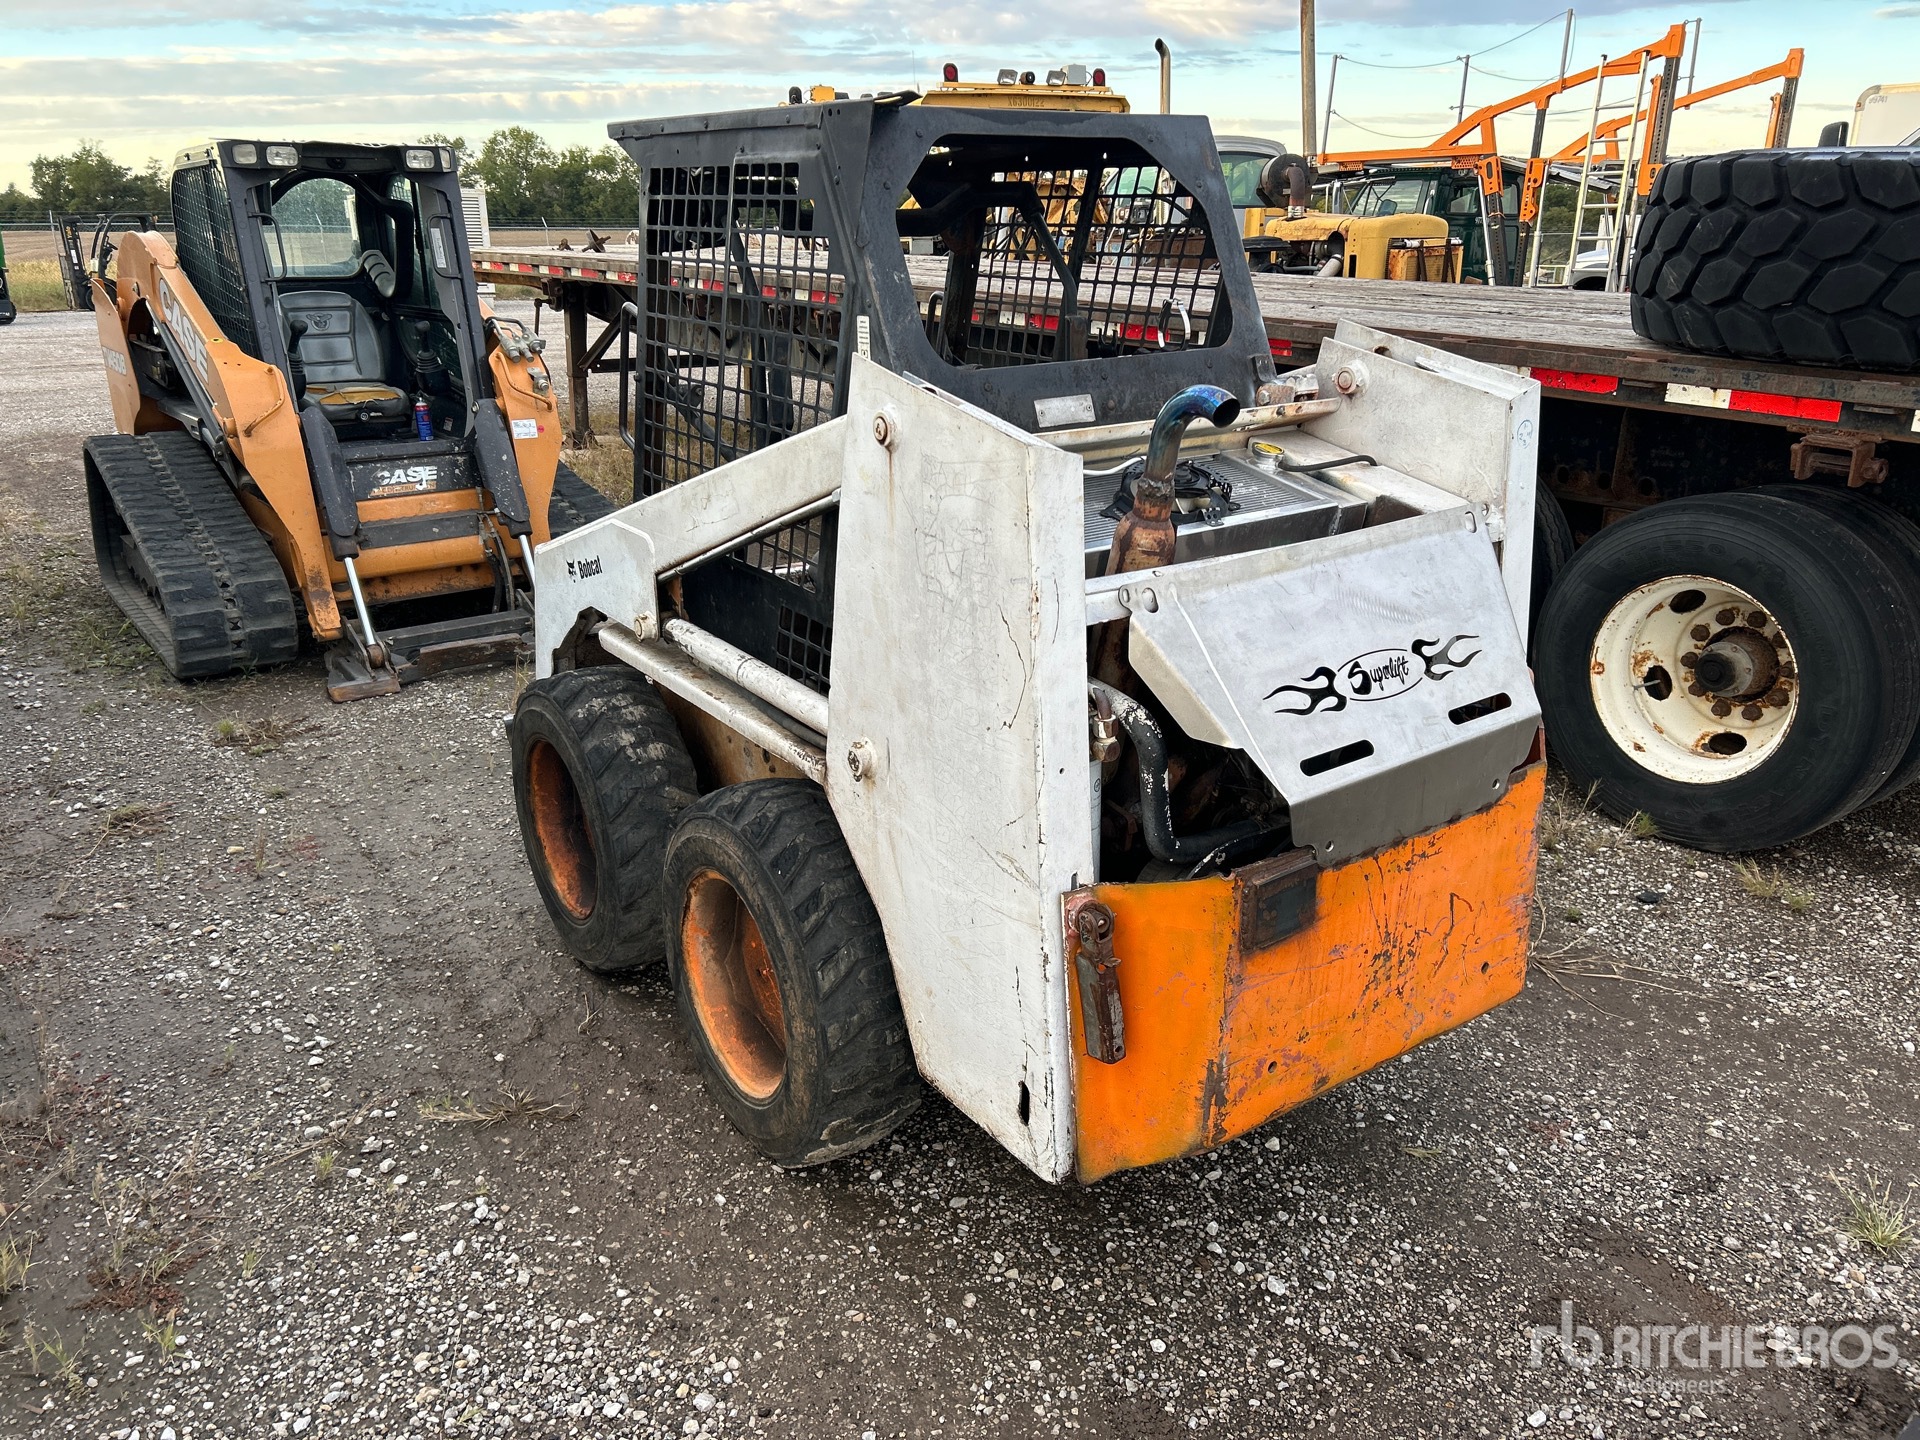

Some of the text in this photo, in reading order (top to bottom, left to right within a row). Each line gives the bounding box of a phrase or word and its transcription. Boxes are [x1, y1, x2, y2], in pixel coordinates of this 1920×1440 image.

[159, 278, 209, 384] CASE
[377, 466, 437, 485] CASE
[577, 555, 603, 580] Bobcat
[1347, 655, 1410, 696] Superlift
